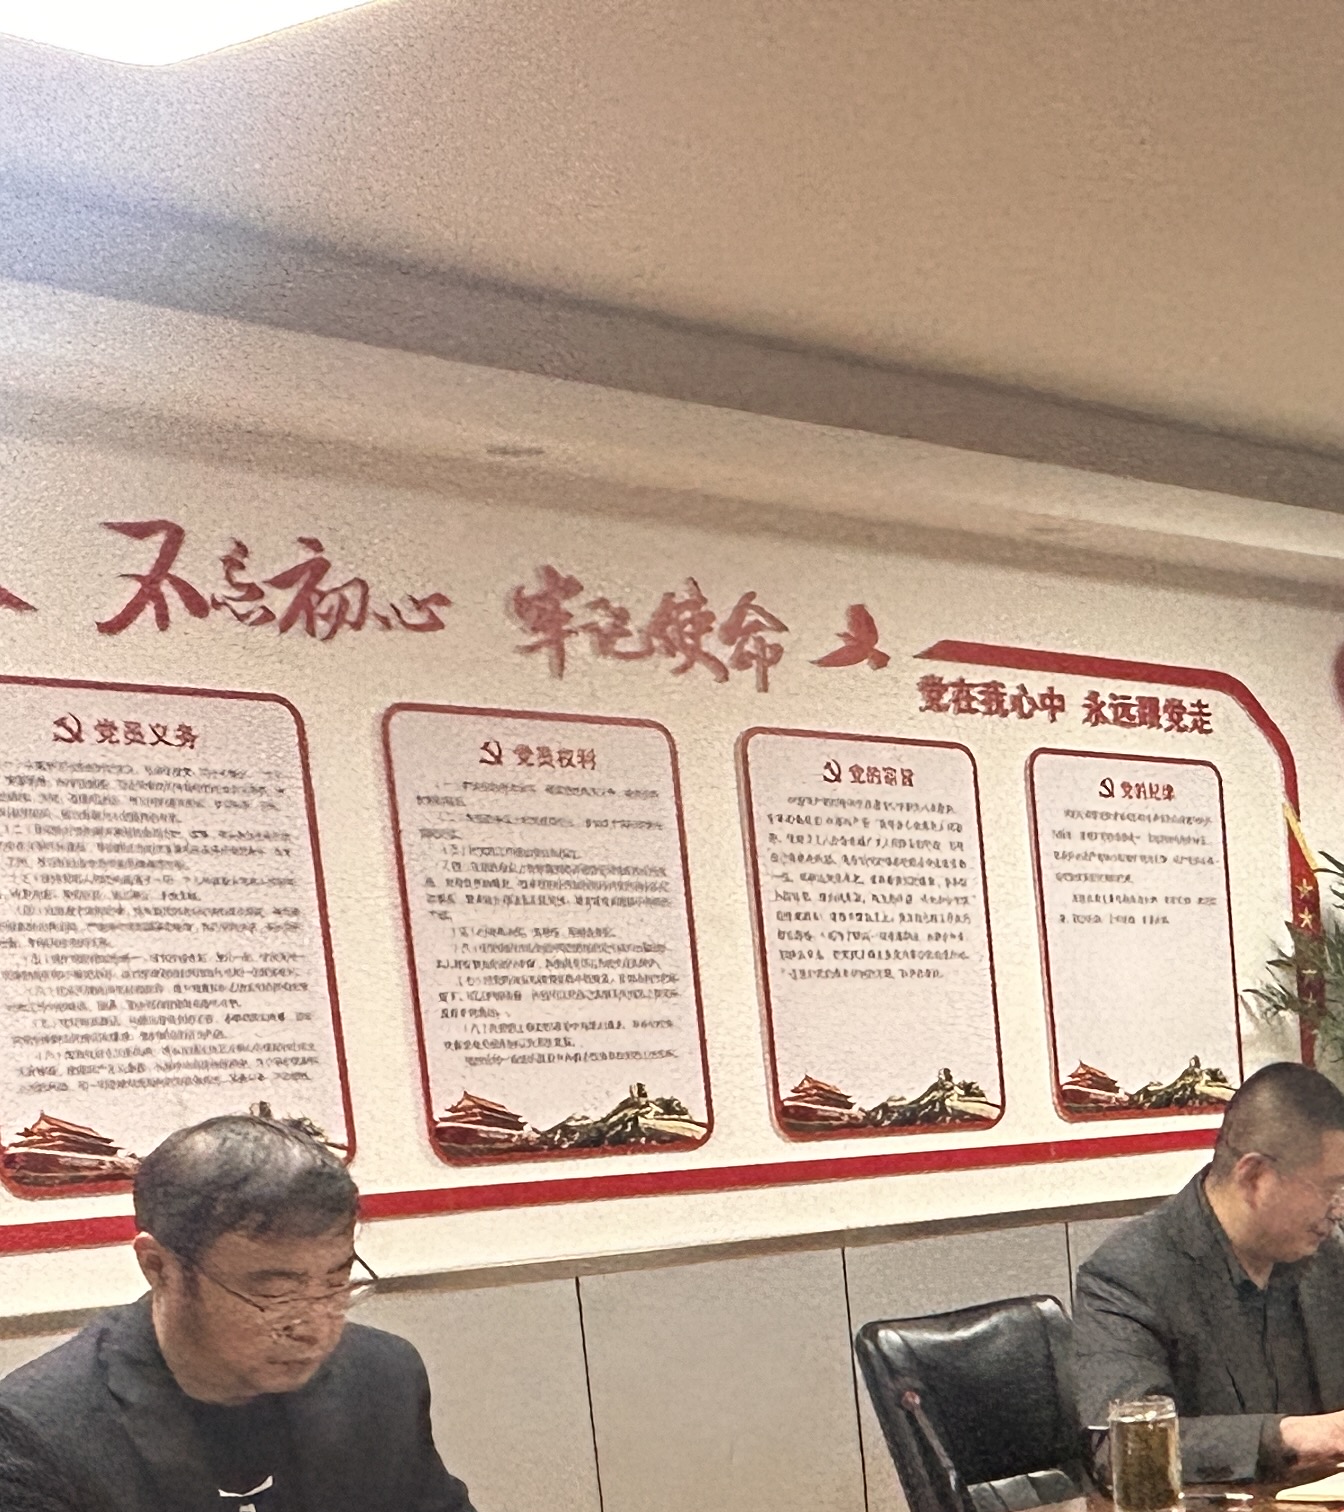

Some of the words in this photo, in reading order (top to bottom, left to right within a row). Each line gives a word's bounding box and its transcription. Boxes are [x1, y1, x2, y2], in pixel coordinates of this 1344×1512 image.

[95, 519, 453, 641] 不忘初心
[506, 564, 790, 693] 牢记使命
[916, 674, 1066, 723] 党在我心中
[1081, 690, 1213, 735] 永远跟党走
[94, 718, 199, 749] 党员义务
[512, 743, 596, 770] 党员权利
